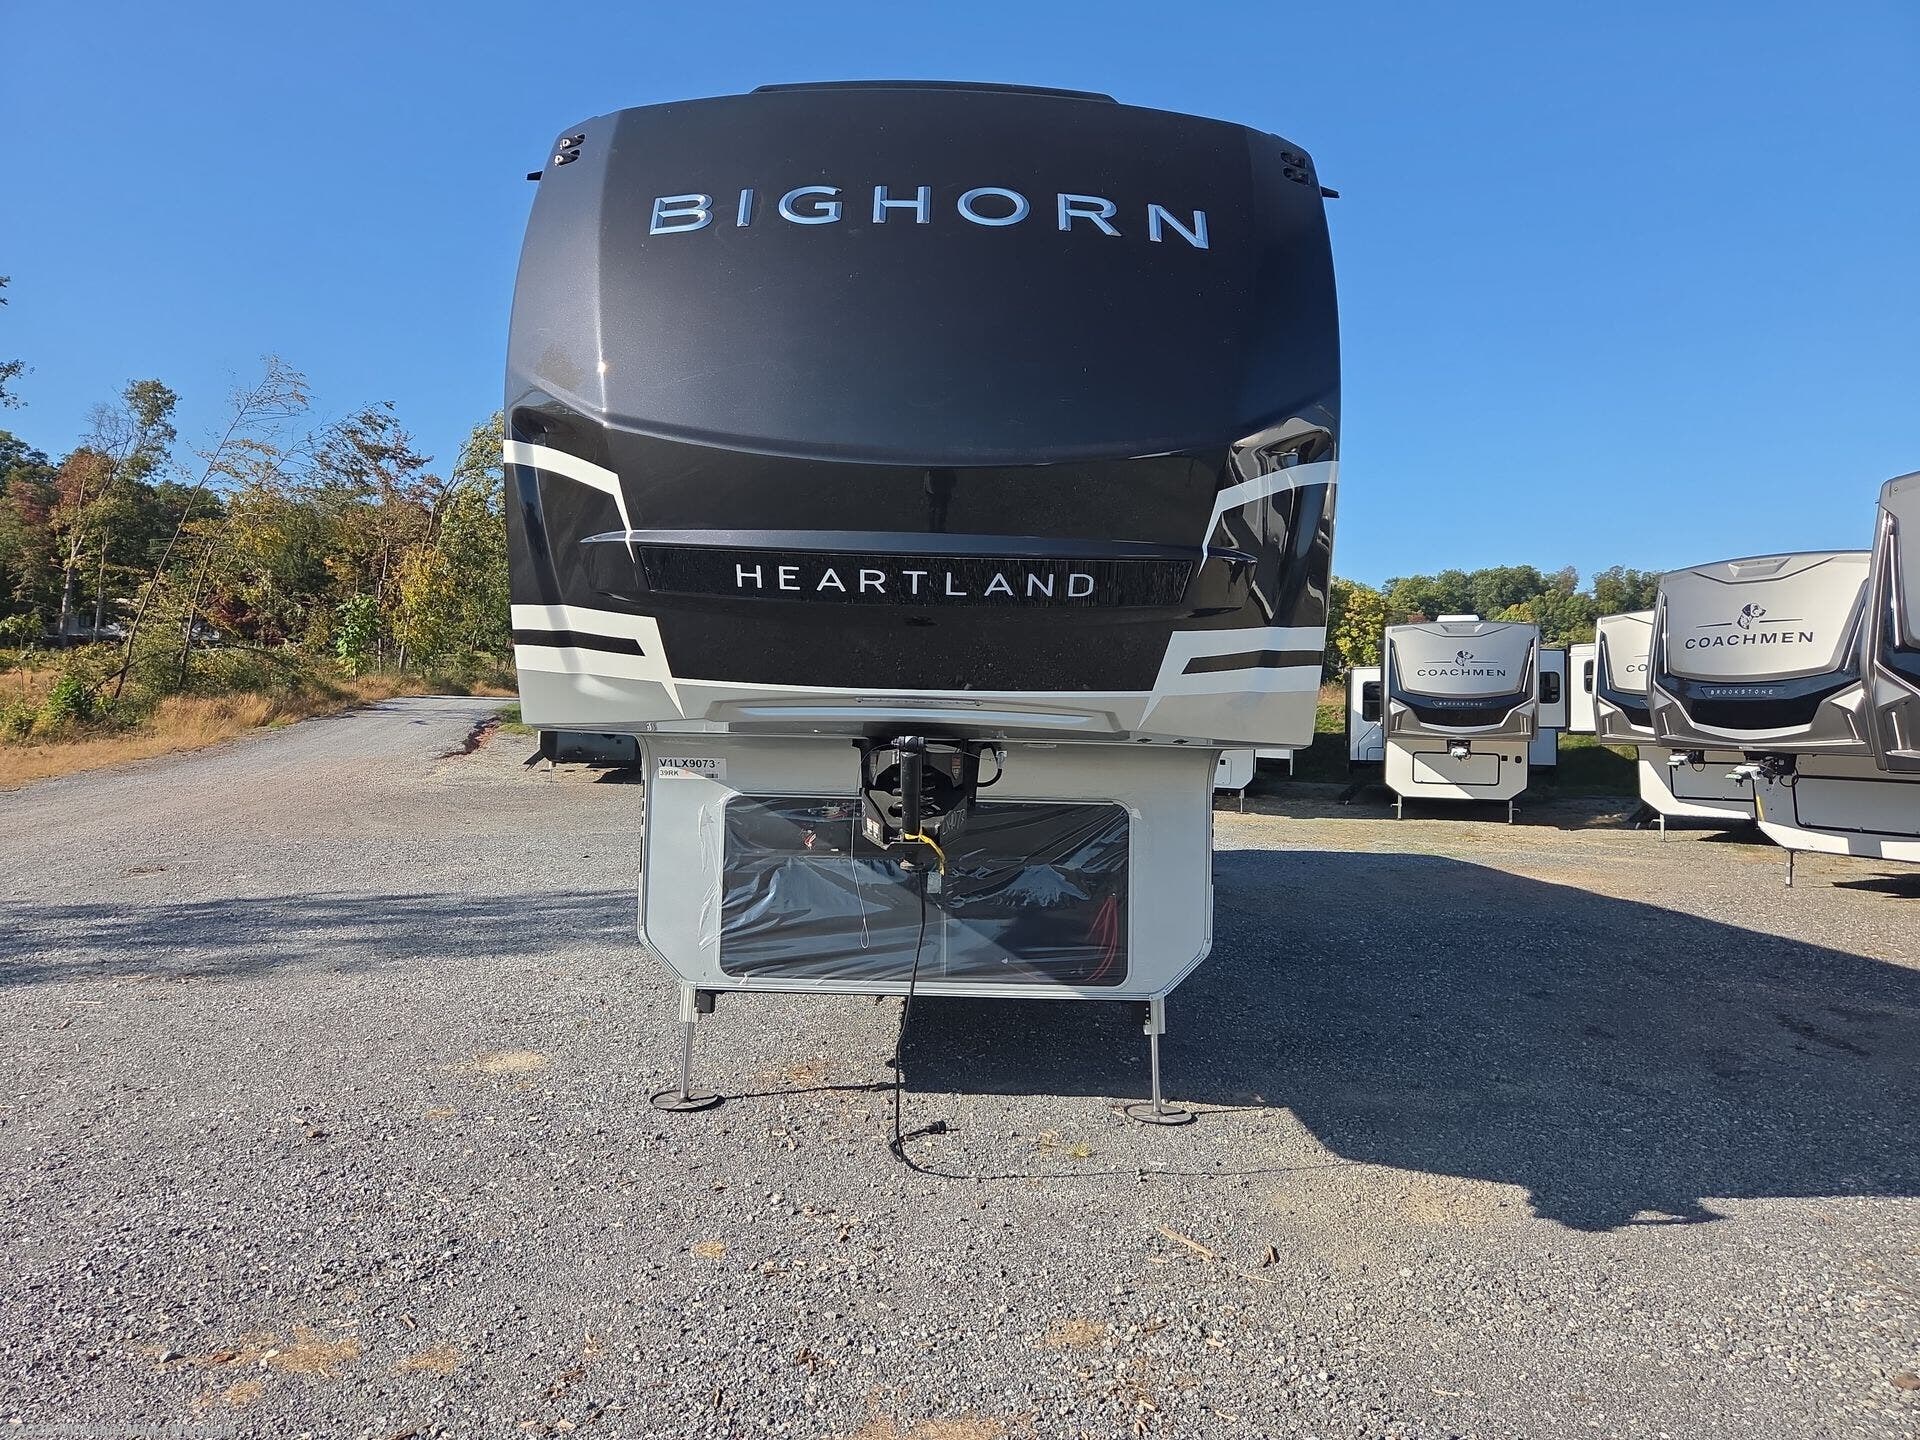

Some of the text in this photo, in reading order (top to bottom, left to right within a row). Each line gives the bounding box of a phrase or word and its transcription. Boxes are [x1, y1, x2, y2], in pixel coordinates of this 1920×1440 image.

[649, 185, 1210, 250] BIGHORN
[735, 564, 1096, 598] HEARTLAND
[1685, 631, 1814, 650] COACHMEN
[1417, 668, 1506, 677] COACHMEN
[659, 758, 716, 768] V1LX9073
